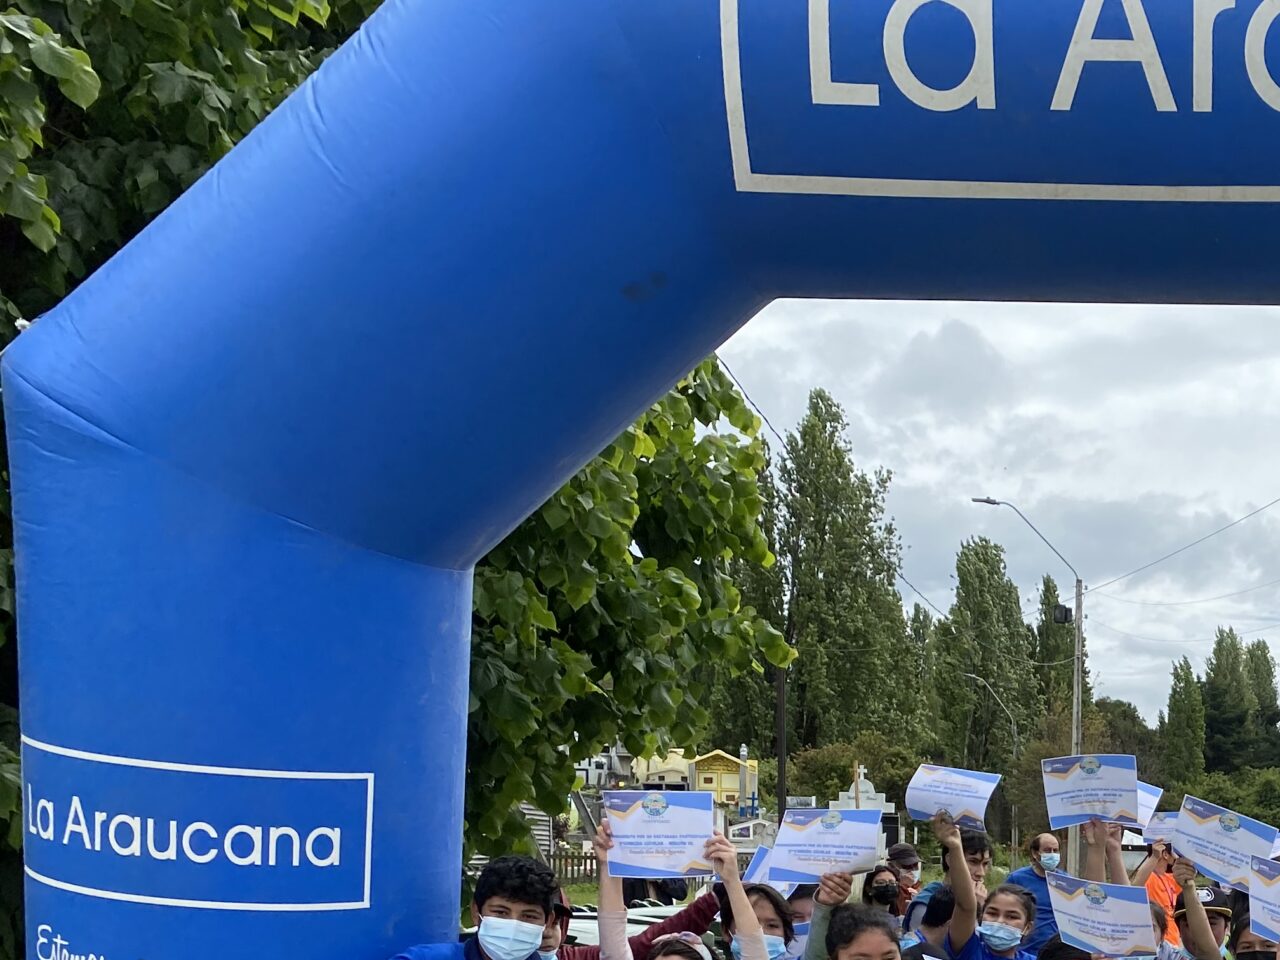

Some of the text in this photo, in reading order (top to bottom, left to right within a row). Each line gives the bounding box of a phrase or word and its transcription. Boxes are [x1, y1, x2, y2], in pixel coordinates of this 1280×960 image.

[809, 0, 996, 111] La
[27, 782, 342, 867] La Araucana
